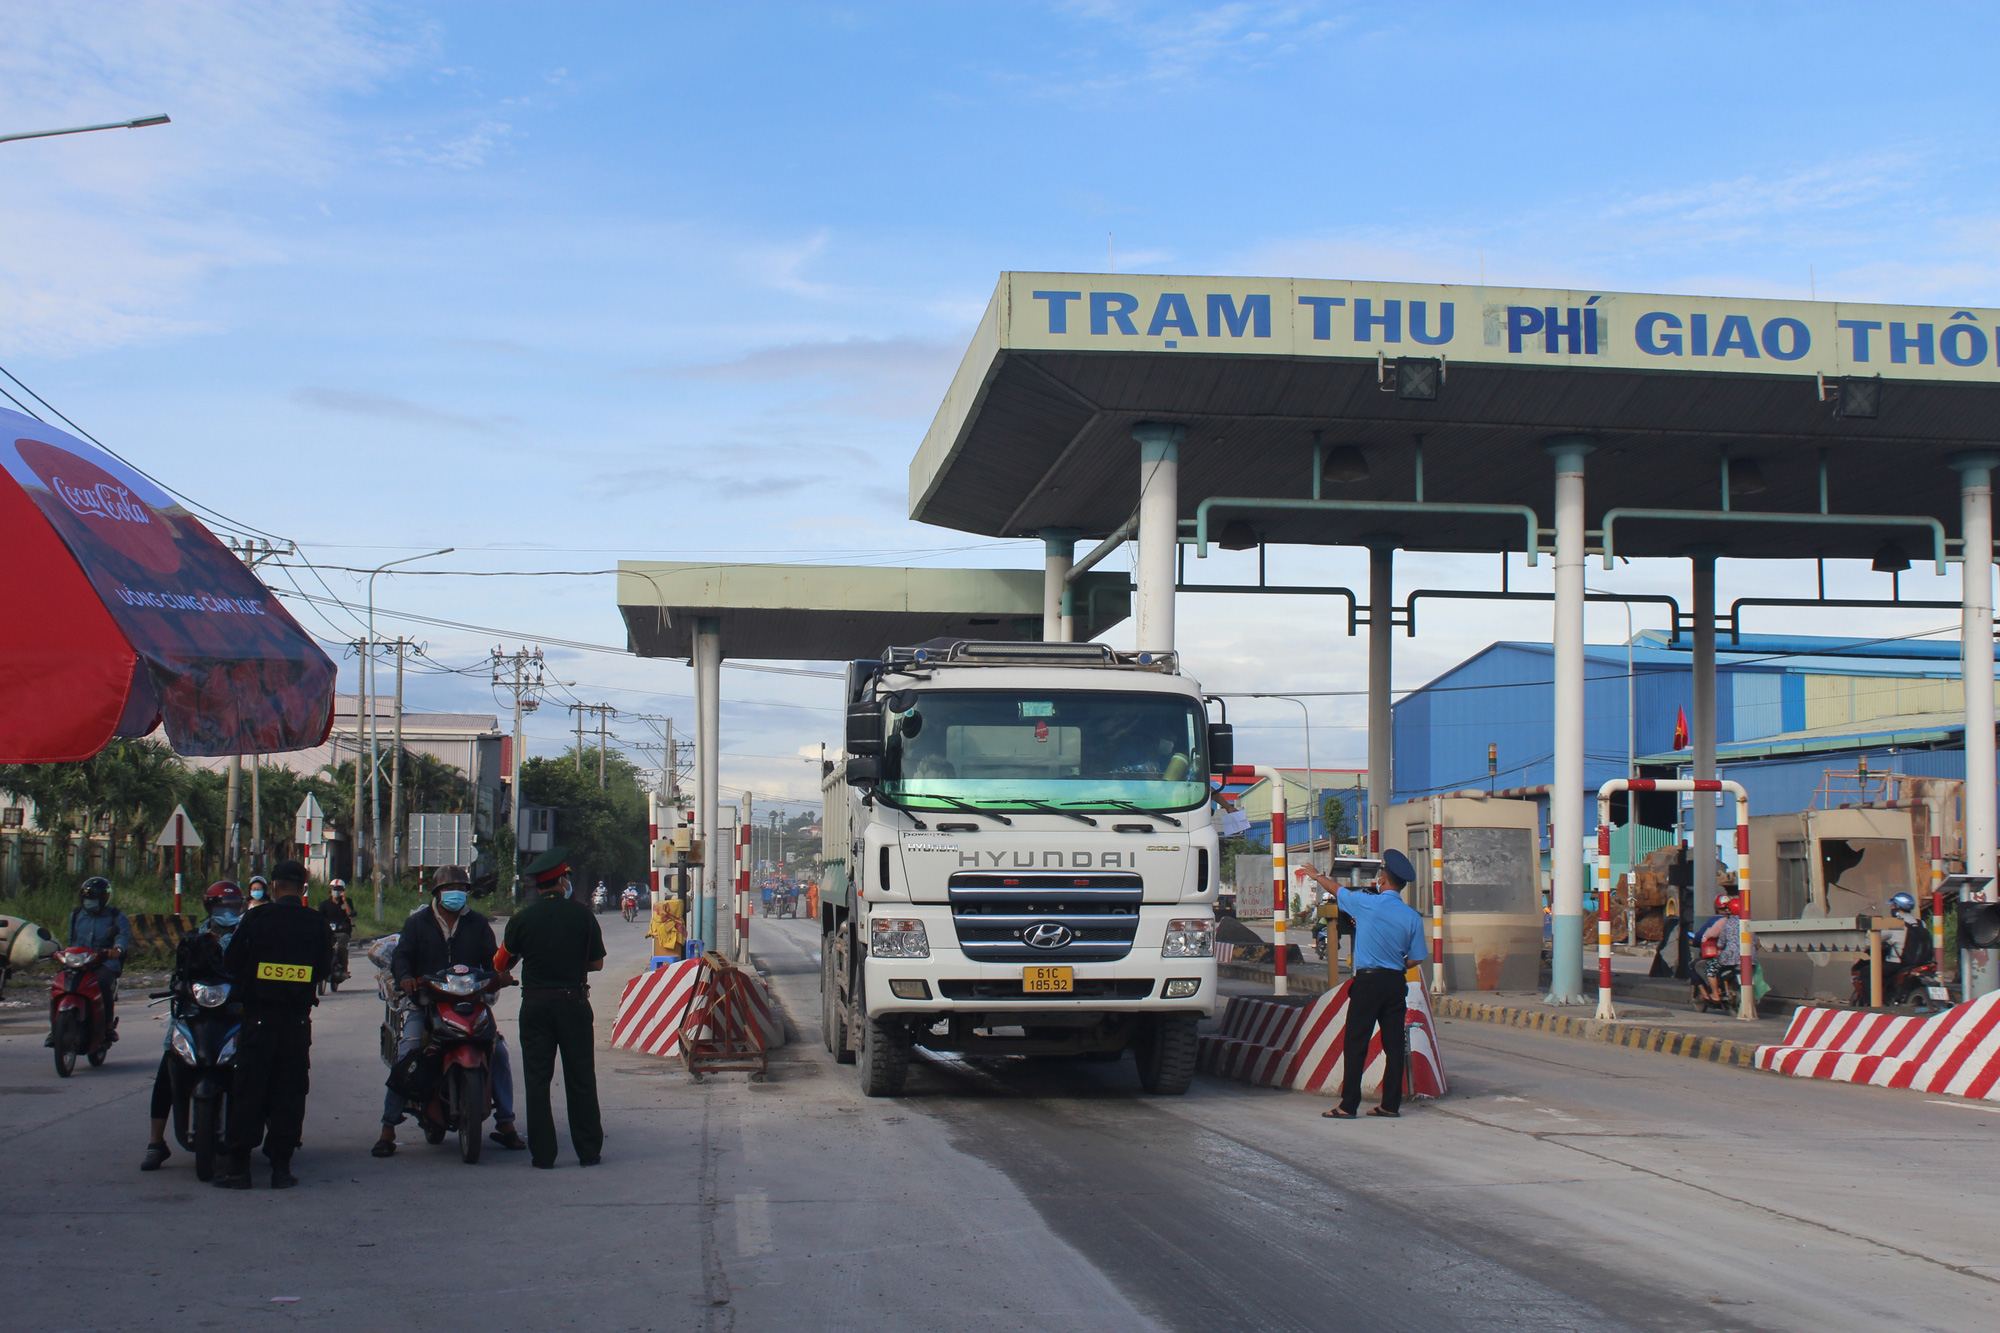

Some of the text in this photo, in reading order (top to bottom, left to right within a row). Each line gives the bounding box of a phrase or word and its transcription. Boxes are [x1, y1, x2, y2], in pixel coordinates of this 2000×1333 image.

[1032, 290, 2000, 368] TRẠM THU PHÍ GIAO THÔ
[160, 590, 206, 612] CÙNG
[201, 592, 238, 614] CẢM
[907, 843, 959, 852] HYUNDAI
[958, 850, 1136, 868] HYUNDAI
[263, 965, 307, 979] CSCĐ
[1037, 967, 1059, 979] 61C
[1030, 979, 1068, 991] 185.92
